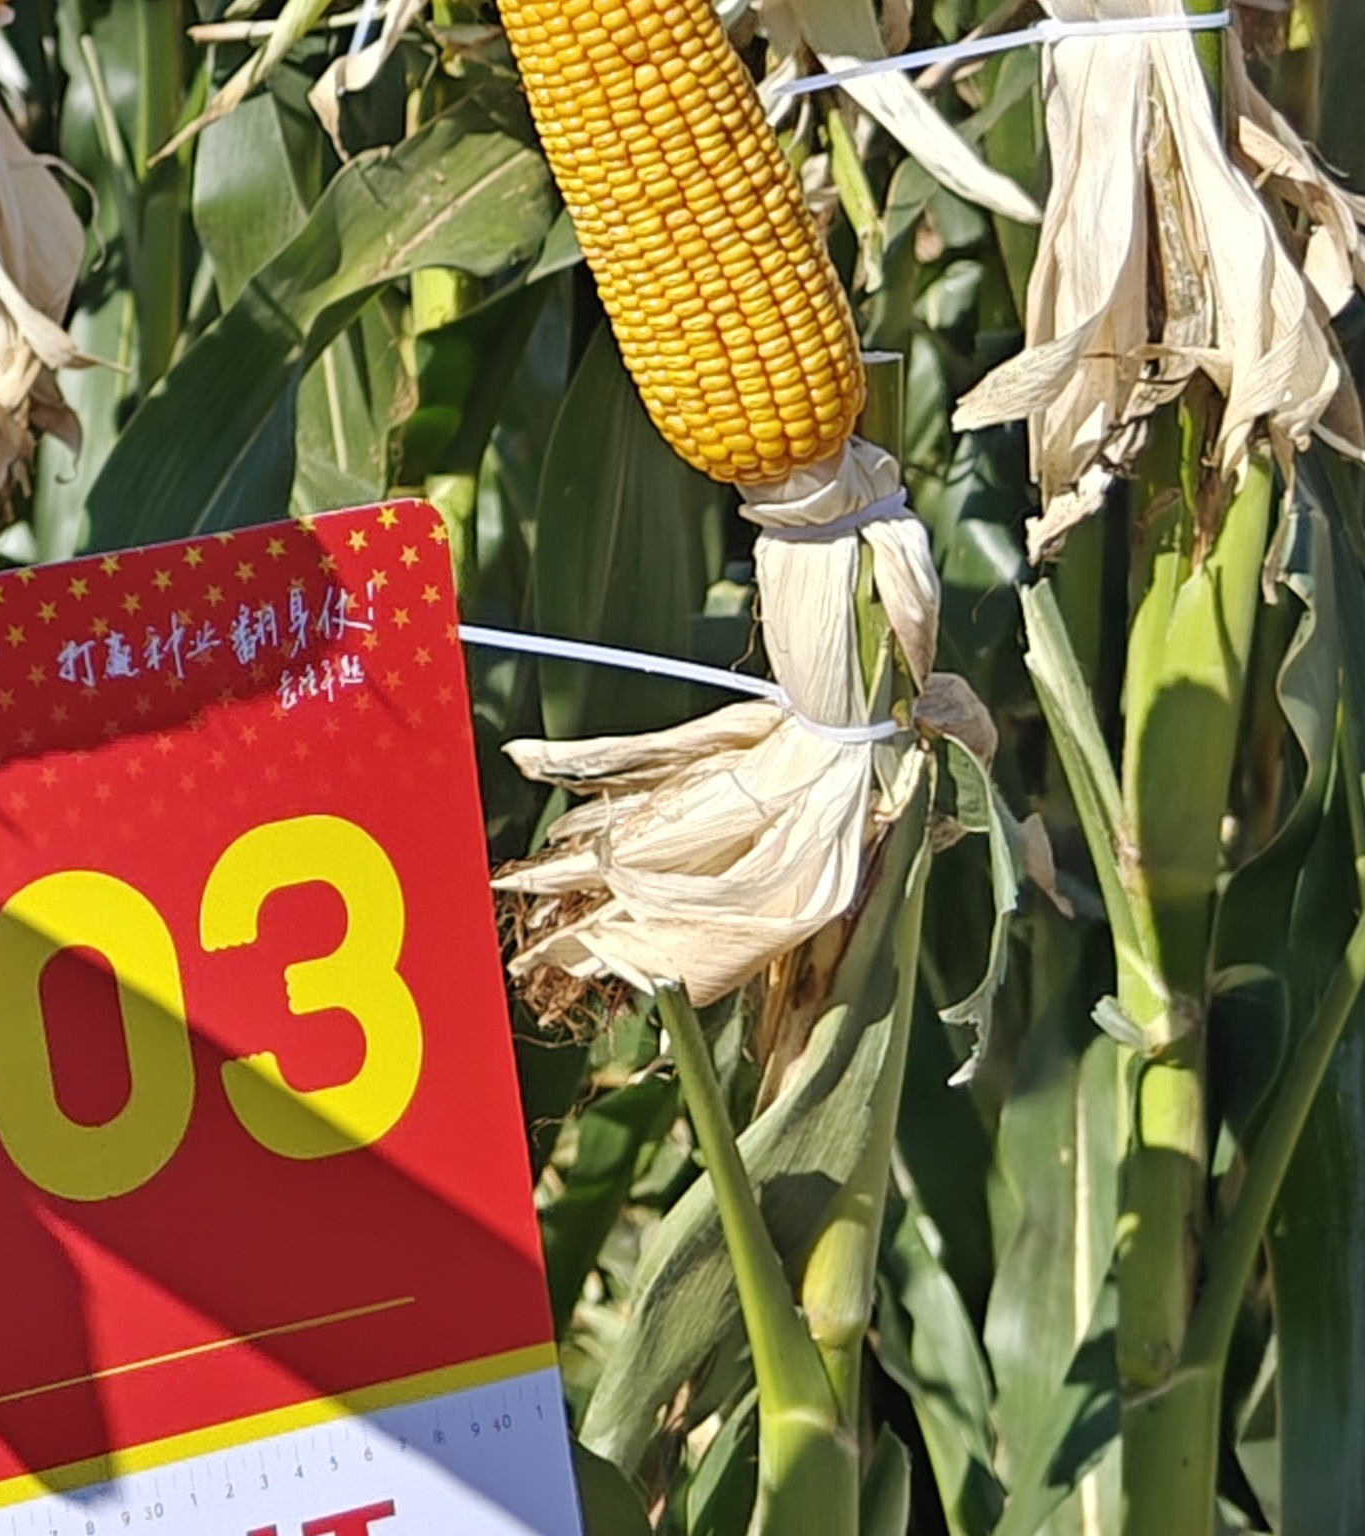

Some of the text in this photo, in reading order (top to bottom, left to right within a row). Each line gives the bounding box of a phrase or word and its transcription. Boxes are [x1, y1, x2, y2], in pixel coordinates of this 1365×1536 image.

[225, 1482, 235, 1500] 2
[259, 1473, 269, 1491] 3
[294, 1464, 305, 1479] 4
[330, 1455, 339, 1472] 5
[470, 1421, 481, 1438] 9
